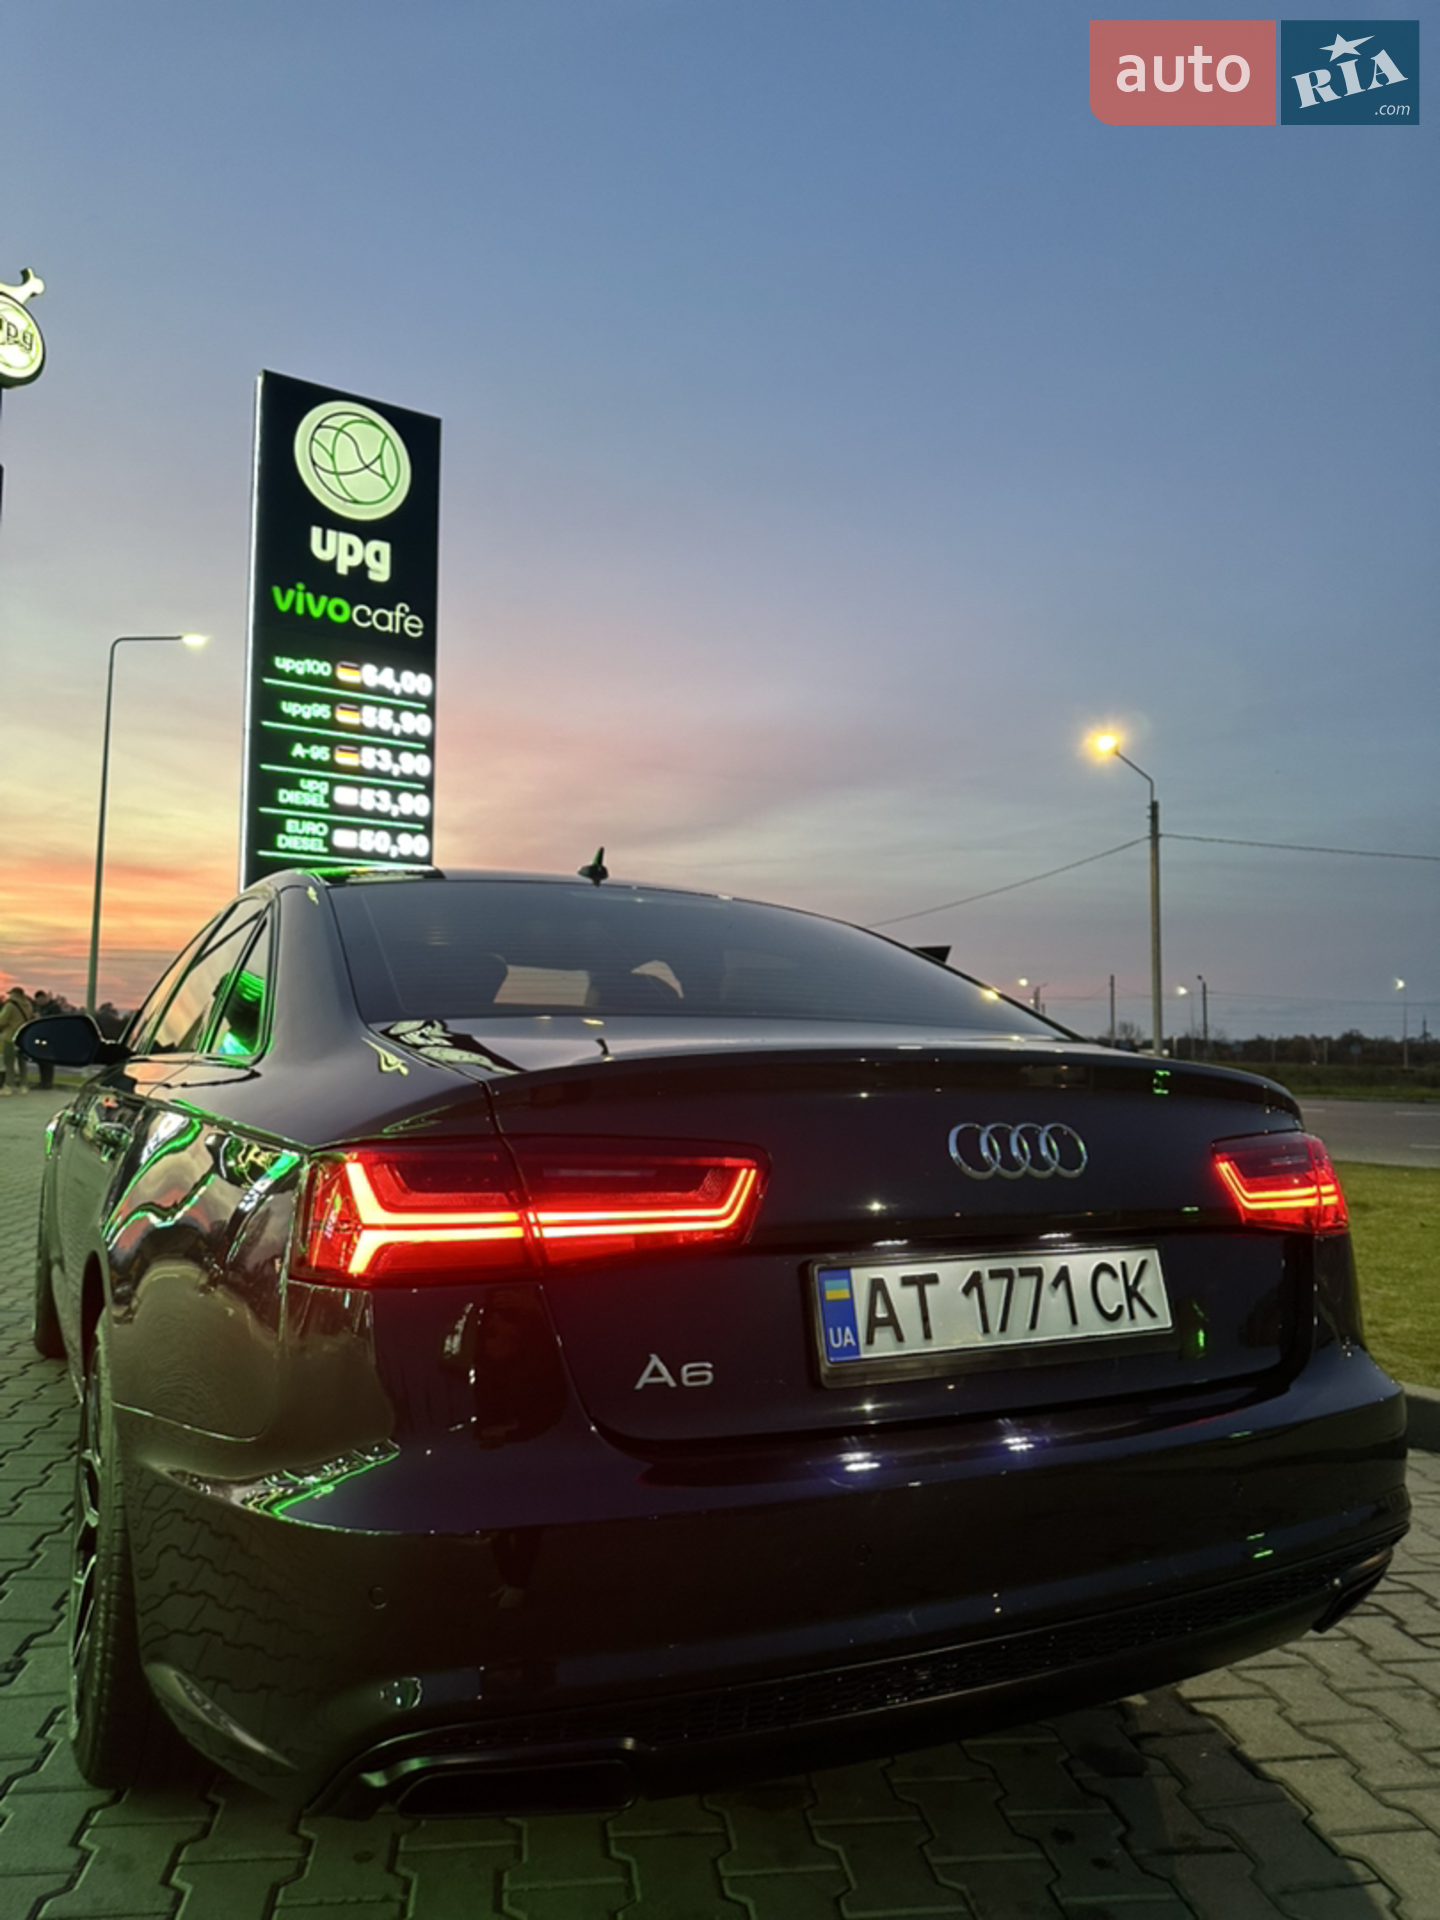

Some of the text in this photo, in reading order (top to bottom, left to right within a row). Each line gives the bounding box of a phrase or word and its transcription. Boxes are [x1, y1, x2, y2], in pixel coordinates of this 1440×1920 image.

[310, 525, 392, 583] upg
[274, 656, 332, 677] upg100
[277, 789, 330, 809] DIESEL
[285, 819, 329, 837] EURO
[276, 834, 329, 853] DIESEL
[865, 1258, 1158, 1346] AT 1771 CK
[829, 1327, 856, 1348] UA
[634, 1353, 714, 1391] A6
